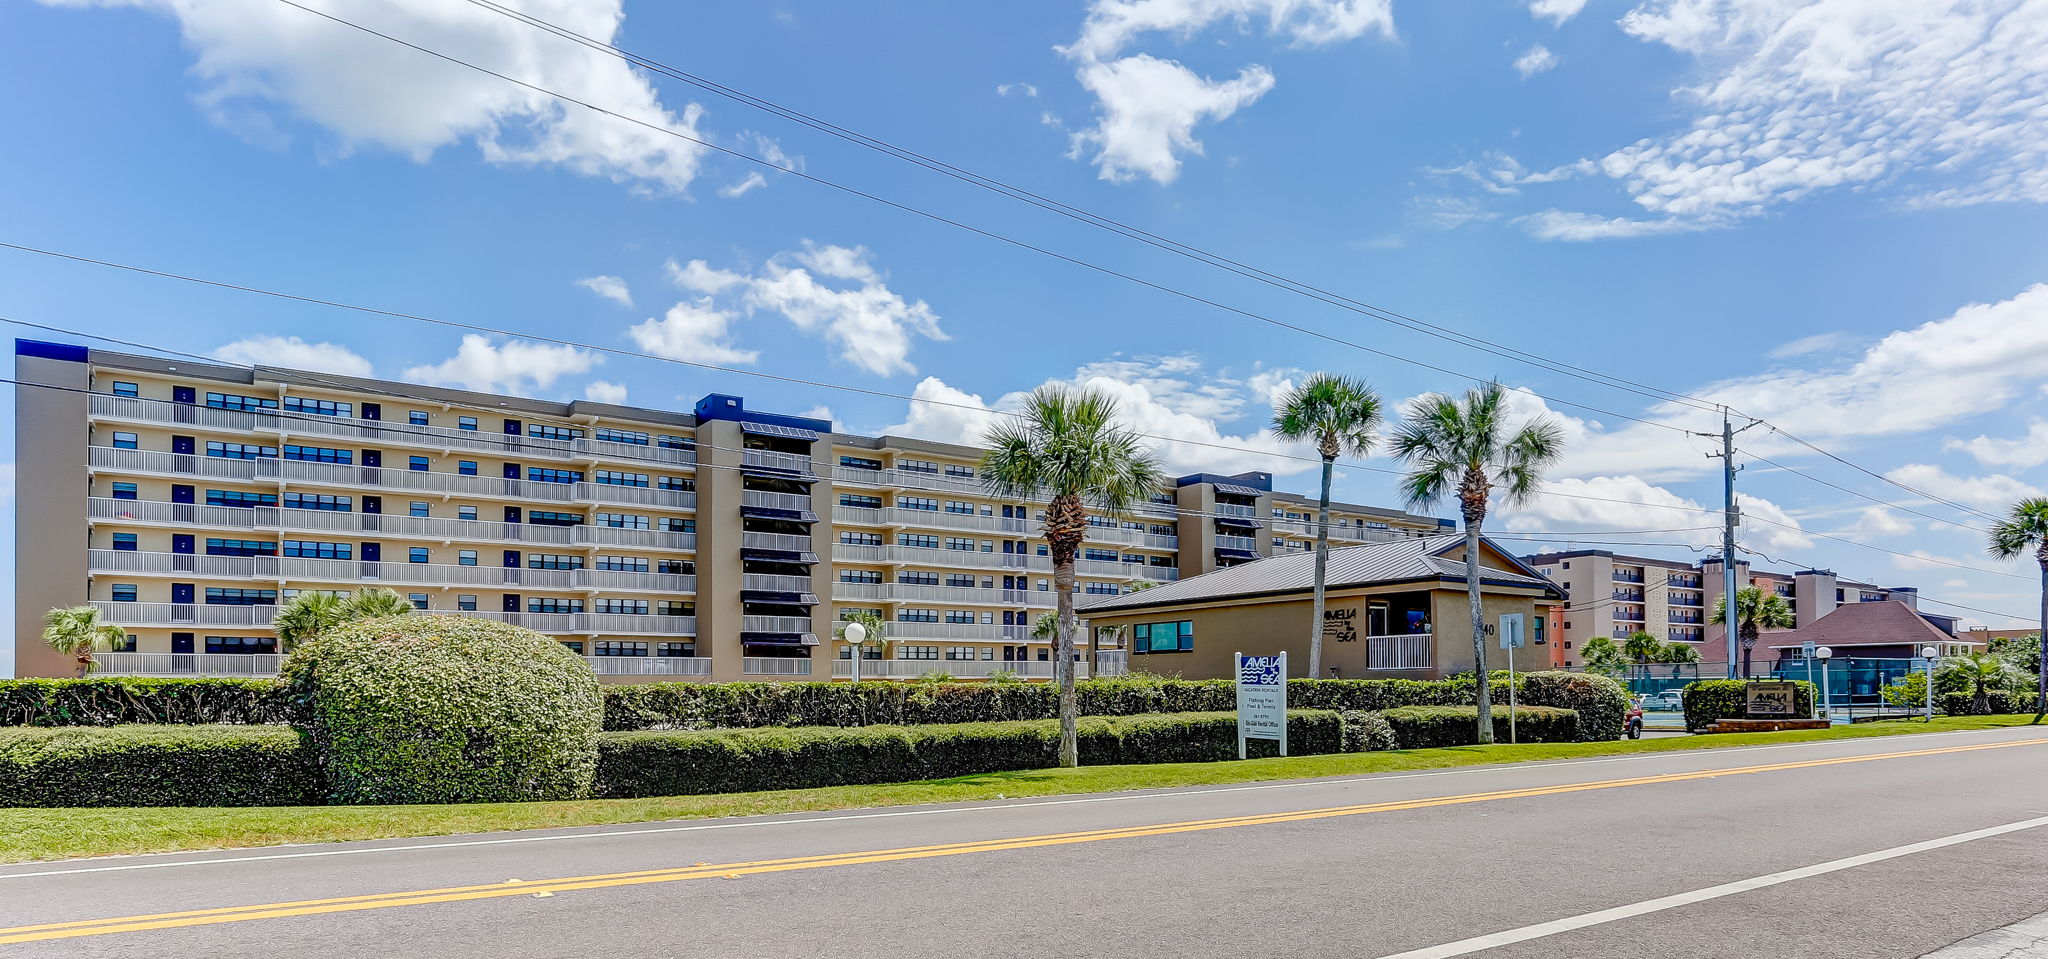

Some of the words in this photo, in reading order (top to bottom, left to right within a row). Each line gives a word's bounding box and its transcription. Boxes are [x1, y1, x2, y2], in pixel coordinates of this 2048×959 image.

[1324, 608, 1357, 620] AMELIA
[1337, 631, 1356, 642] SEA
[1246, 657, 1280, 667] AMELIA
[1261, 674, 1280, 684] SEA
[1754, 692, 1787, 702] AMELIA
